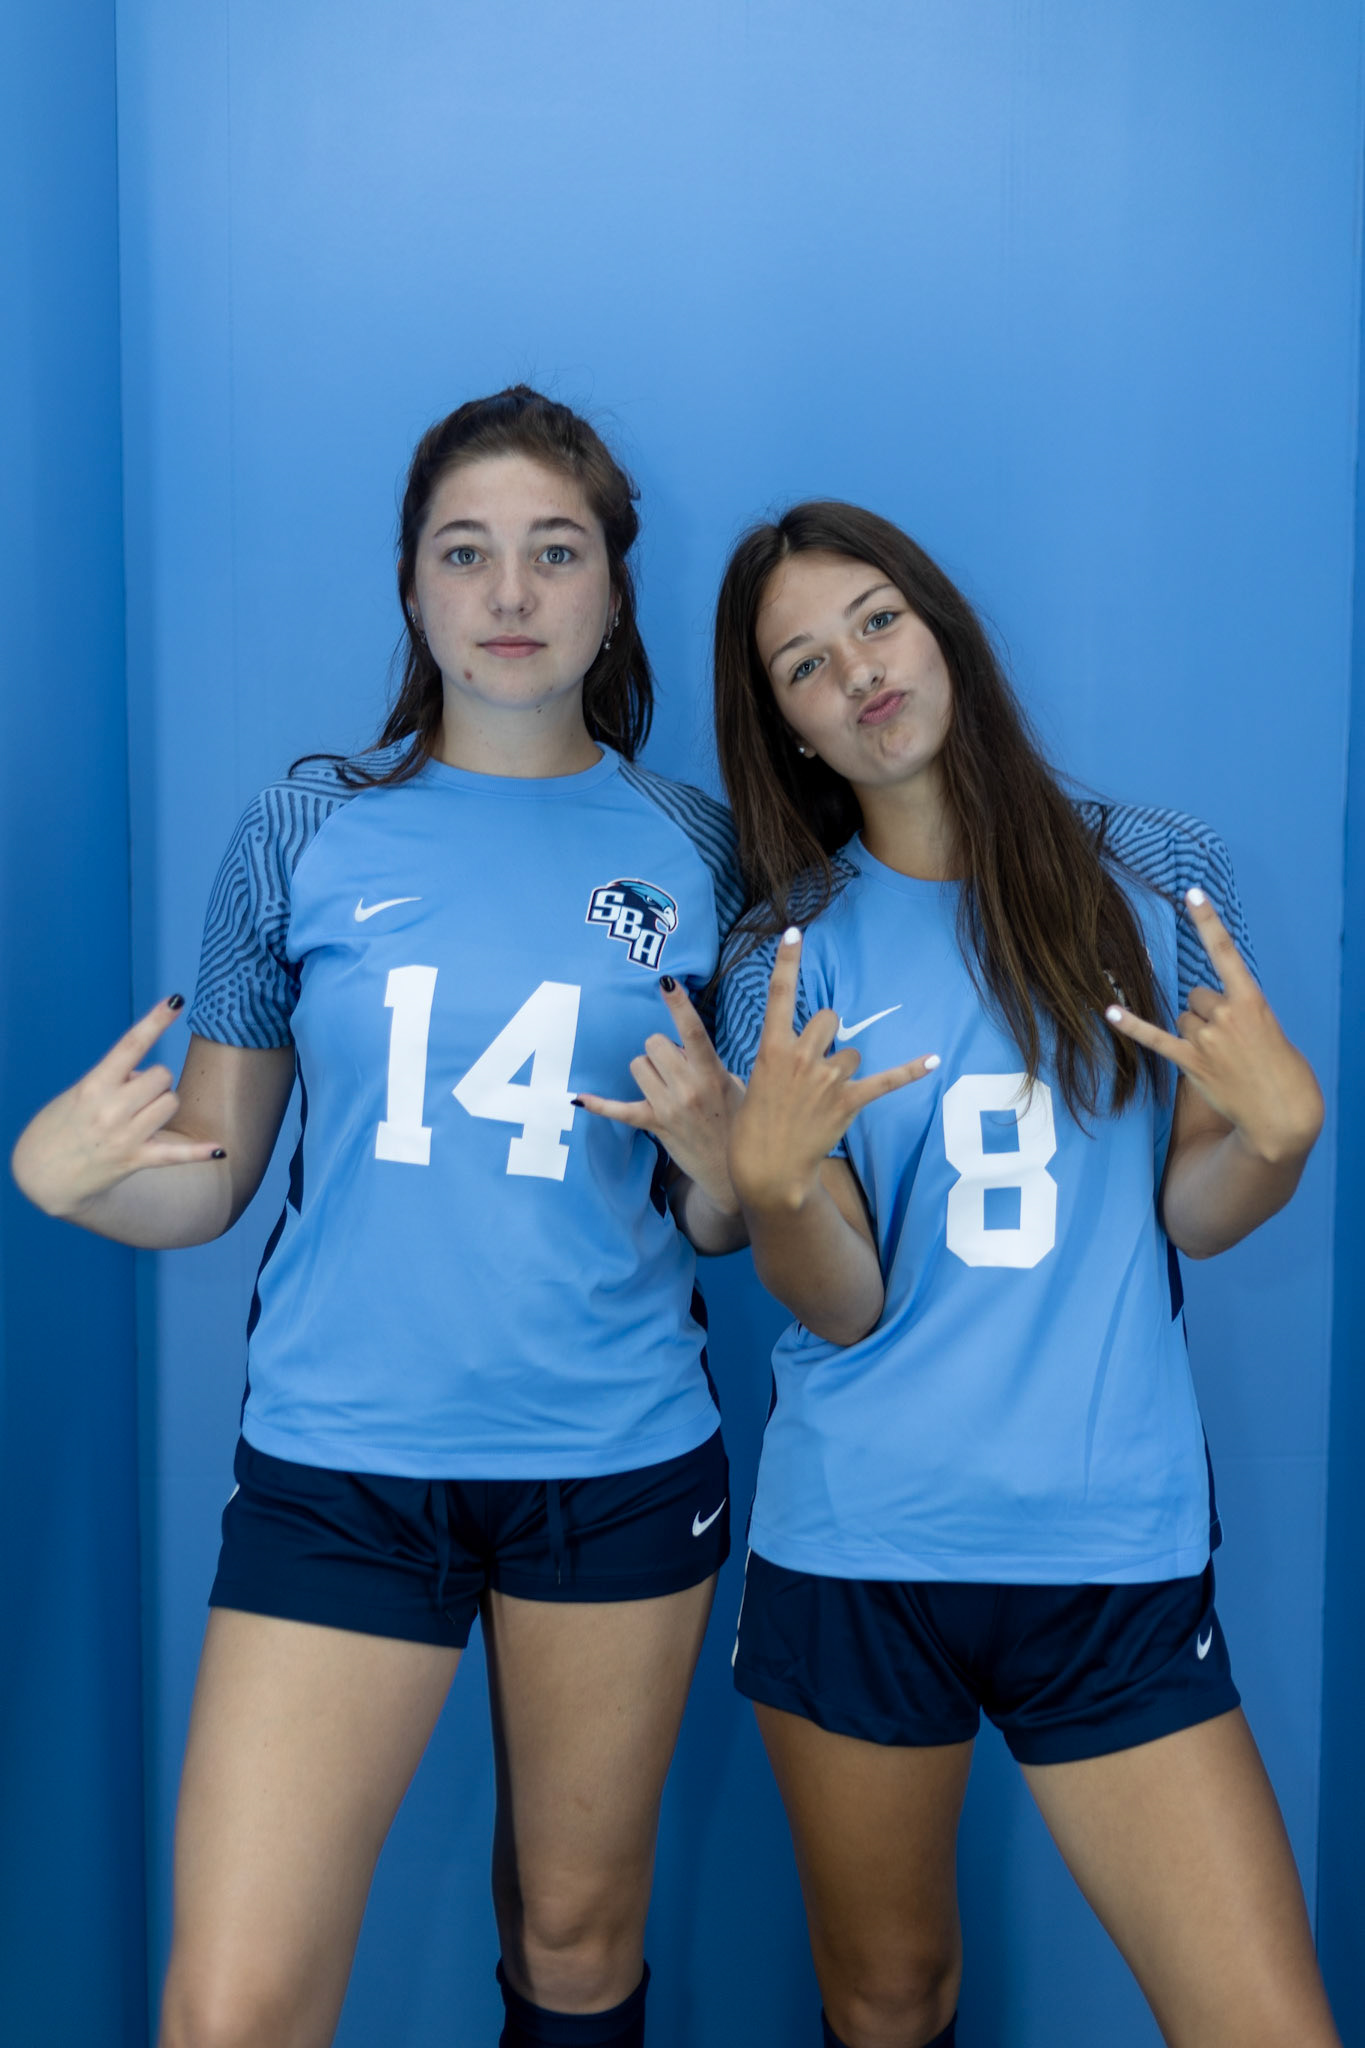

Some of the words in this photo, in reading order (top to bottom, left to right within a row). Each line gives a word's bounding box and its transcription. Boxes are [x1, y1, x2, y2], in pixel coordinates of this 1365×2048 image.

[591, 890, 664, 967] SBA
[374, 964, 582, 1182] 14
[942, 1072, 1058, 1269] 8
